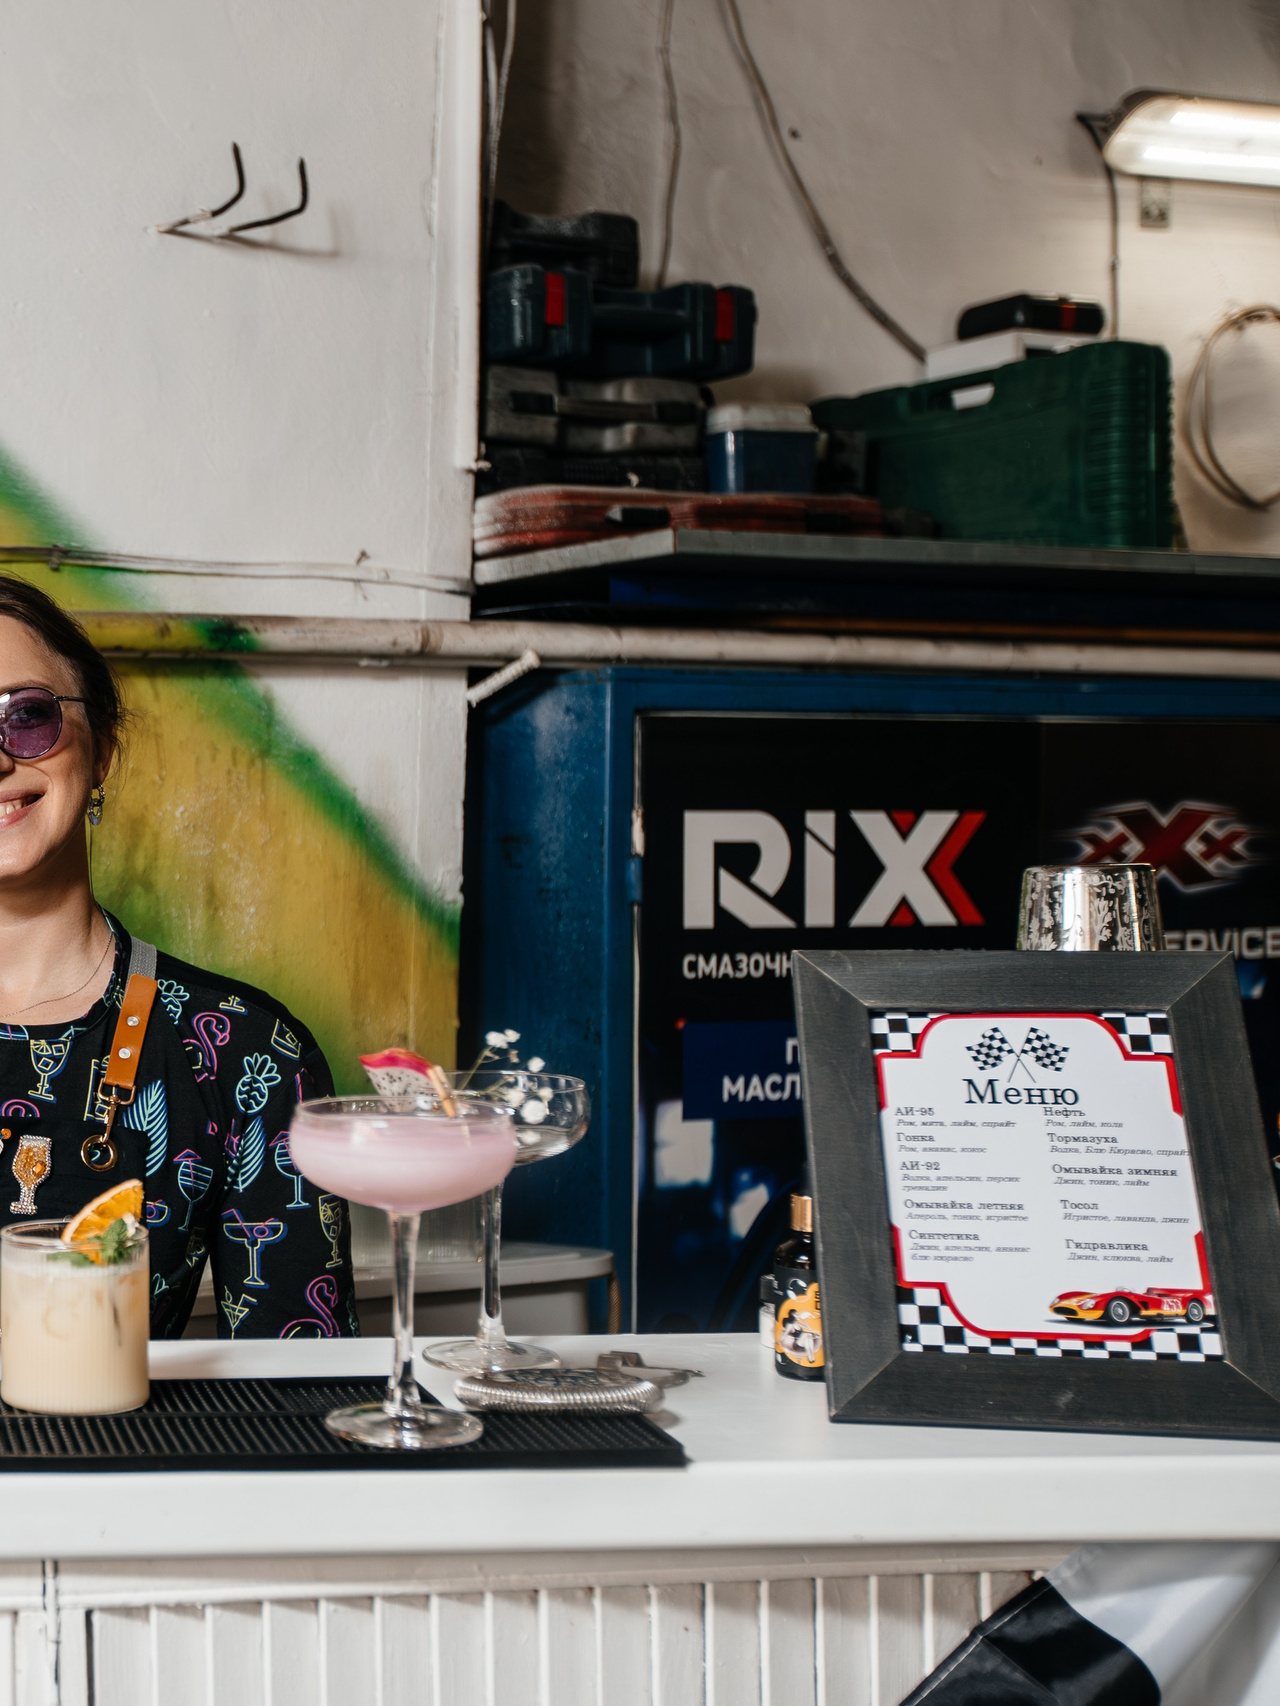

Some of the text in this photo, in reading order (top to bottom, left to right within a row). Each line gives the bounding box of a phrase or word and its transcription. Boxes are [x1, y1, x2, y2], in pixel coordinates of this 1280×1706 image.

[962, 1078, 1080, 1106] Меню
[895, 1107, 935, 1116] АИ-95
[1043, 1107, 1086, 1118] Нефть
[896, 1132, 936, 1142] Гонка
[1047, 1133, 1119, 1144] Тормазуха
[900, 1161, 940, 1170] АИ-92
[1052, 1164, 1178, 1176] Омывайка зимняя
[904, 1199, 1025, 1210] Омывайка летняя
[1060, 1200, 1099, 1210] Тосол
[908, 1230, 980, 1240] Синтетика
[1065, 1239, 1149, 1251] Гидравлика
